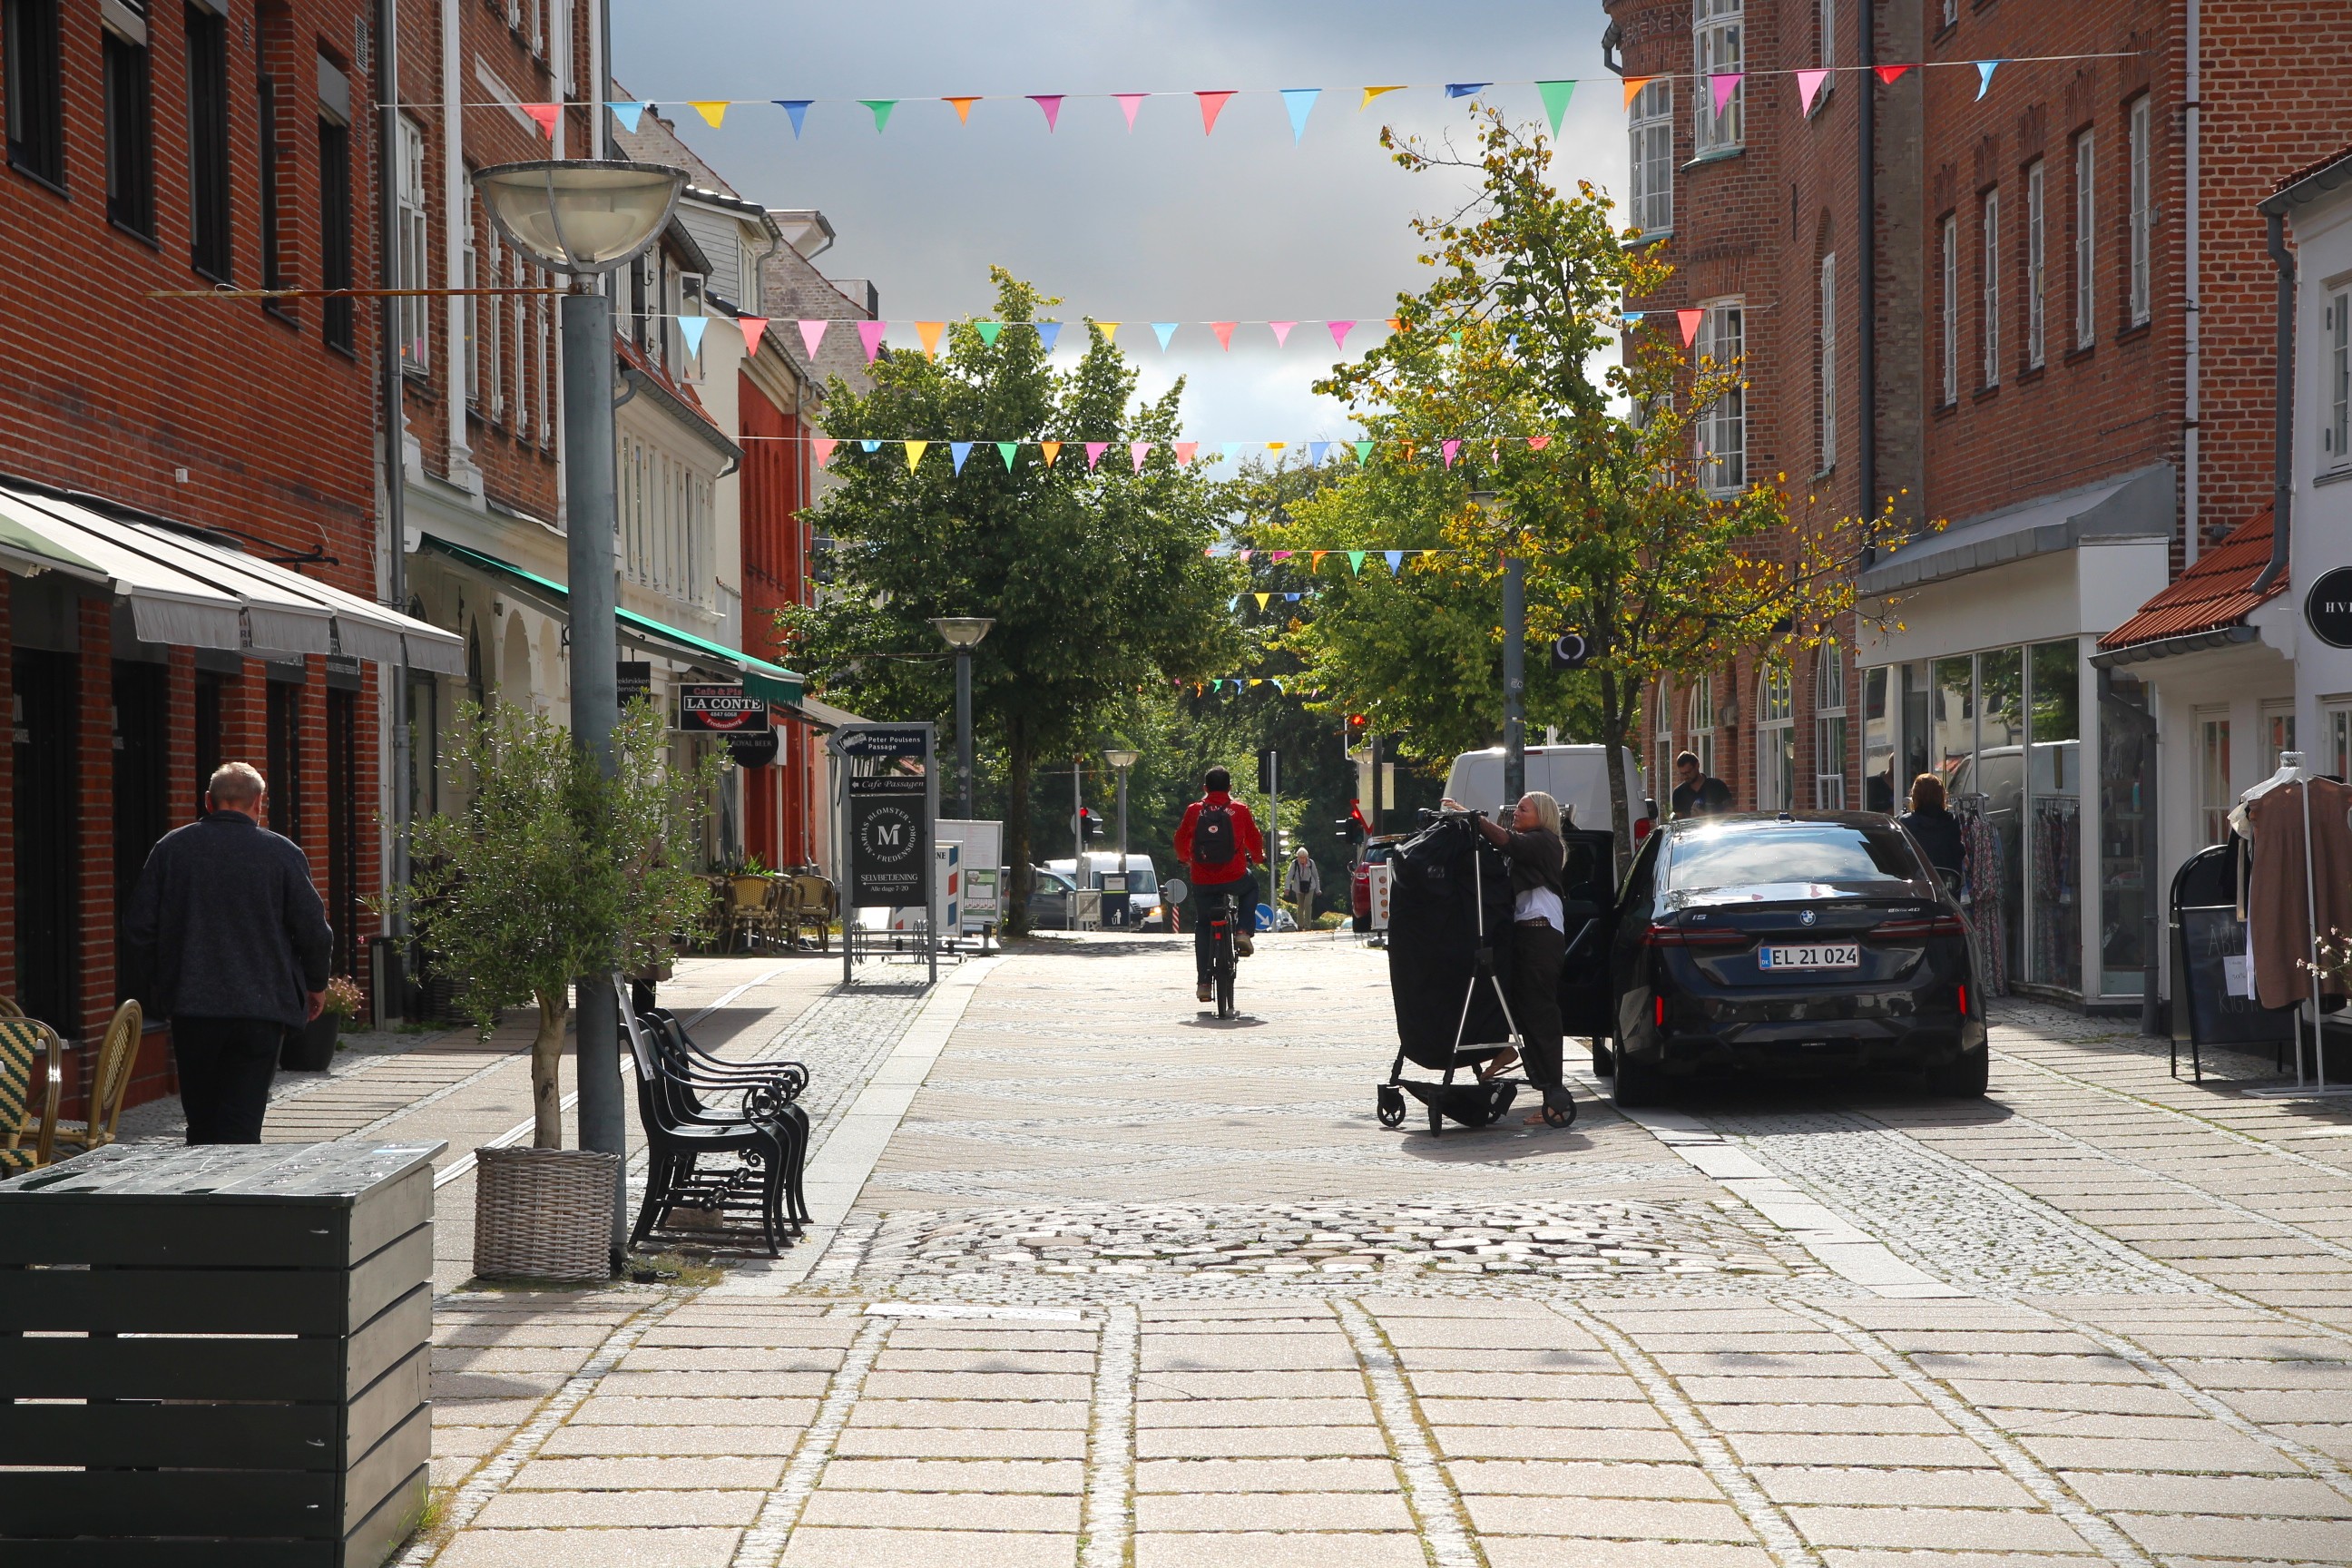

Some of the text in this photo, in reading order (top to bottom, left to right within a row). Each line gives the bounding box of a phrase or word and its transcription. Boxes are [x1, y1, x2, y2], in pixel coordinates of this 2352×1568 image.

[2326, 602, 2352, 612] HV
[693, 687, 715, 696] Cafe
[686, 698, 761, 710] LA CONTE
[706, 718, 742, 729] Fredensborg
[861, 779, 924, 789] Cafe Passagen
[861, 807, 909, 853] MARIAS BLOMSTER
[877, 824, 901, 845] M
[877, 825, 916, 862] FREDENSBORG
[860, 873, 918, 882] SELVBETJENING
[1772, 947, 1857, 965] EL 21 024
